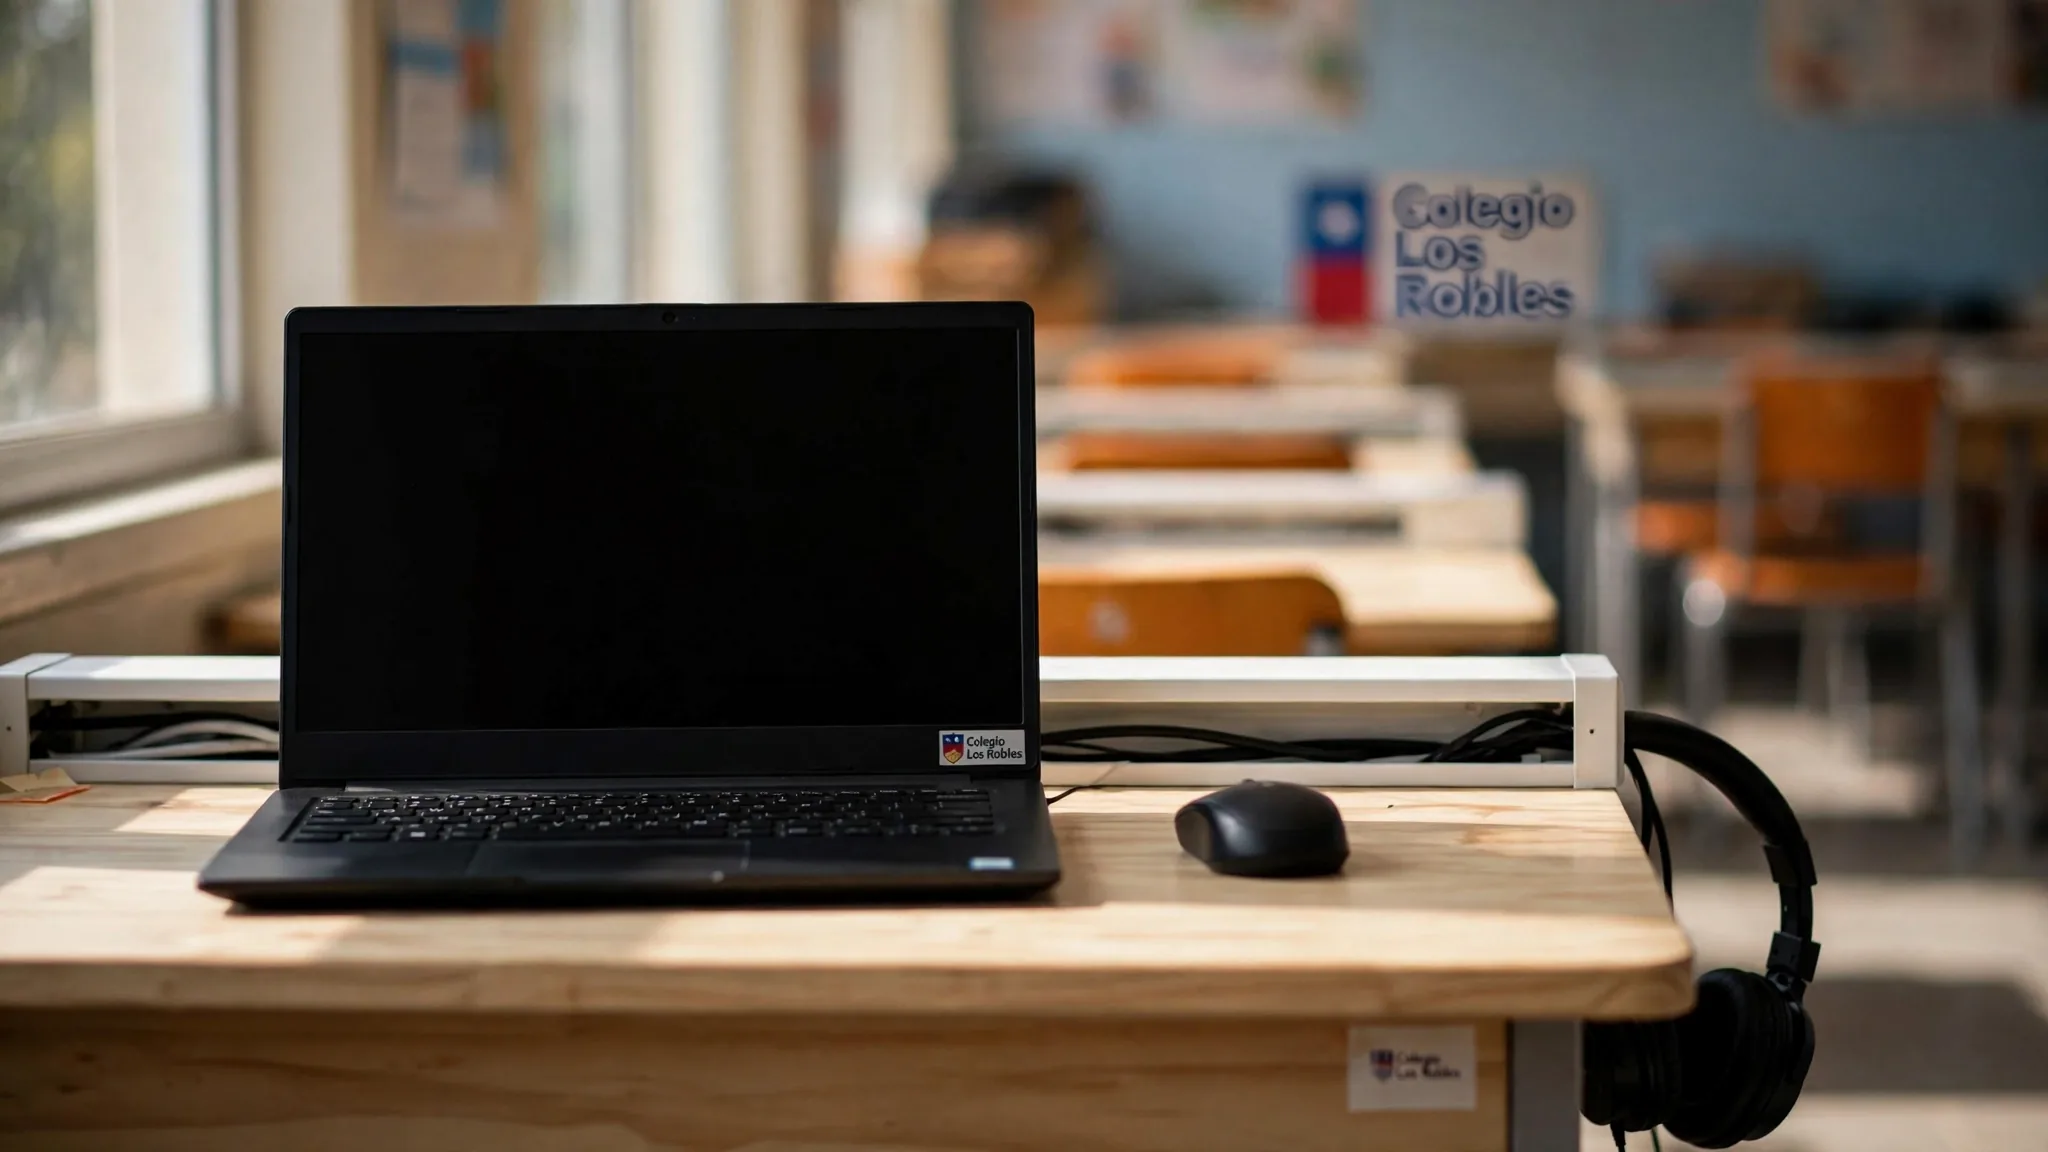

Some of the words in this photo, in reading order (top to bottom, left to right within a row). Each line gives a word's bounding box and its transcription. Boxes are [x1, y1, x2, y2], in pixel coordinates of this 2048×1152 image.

[1396, 231, 1486, 271] Los
[966, 736, 1005, 749] Colegio
[967, 749, 984, 759] Los
[987, 748, 1023, 759] Robles
